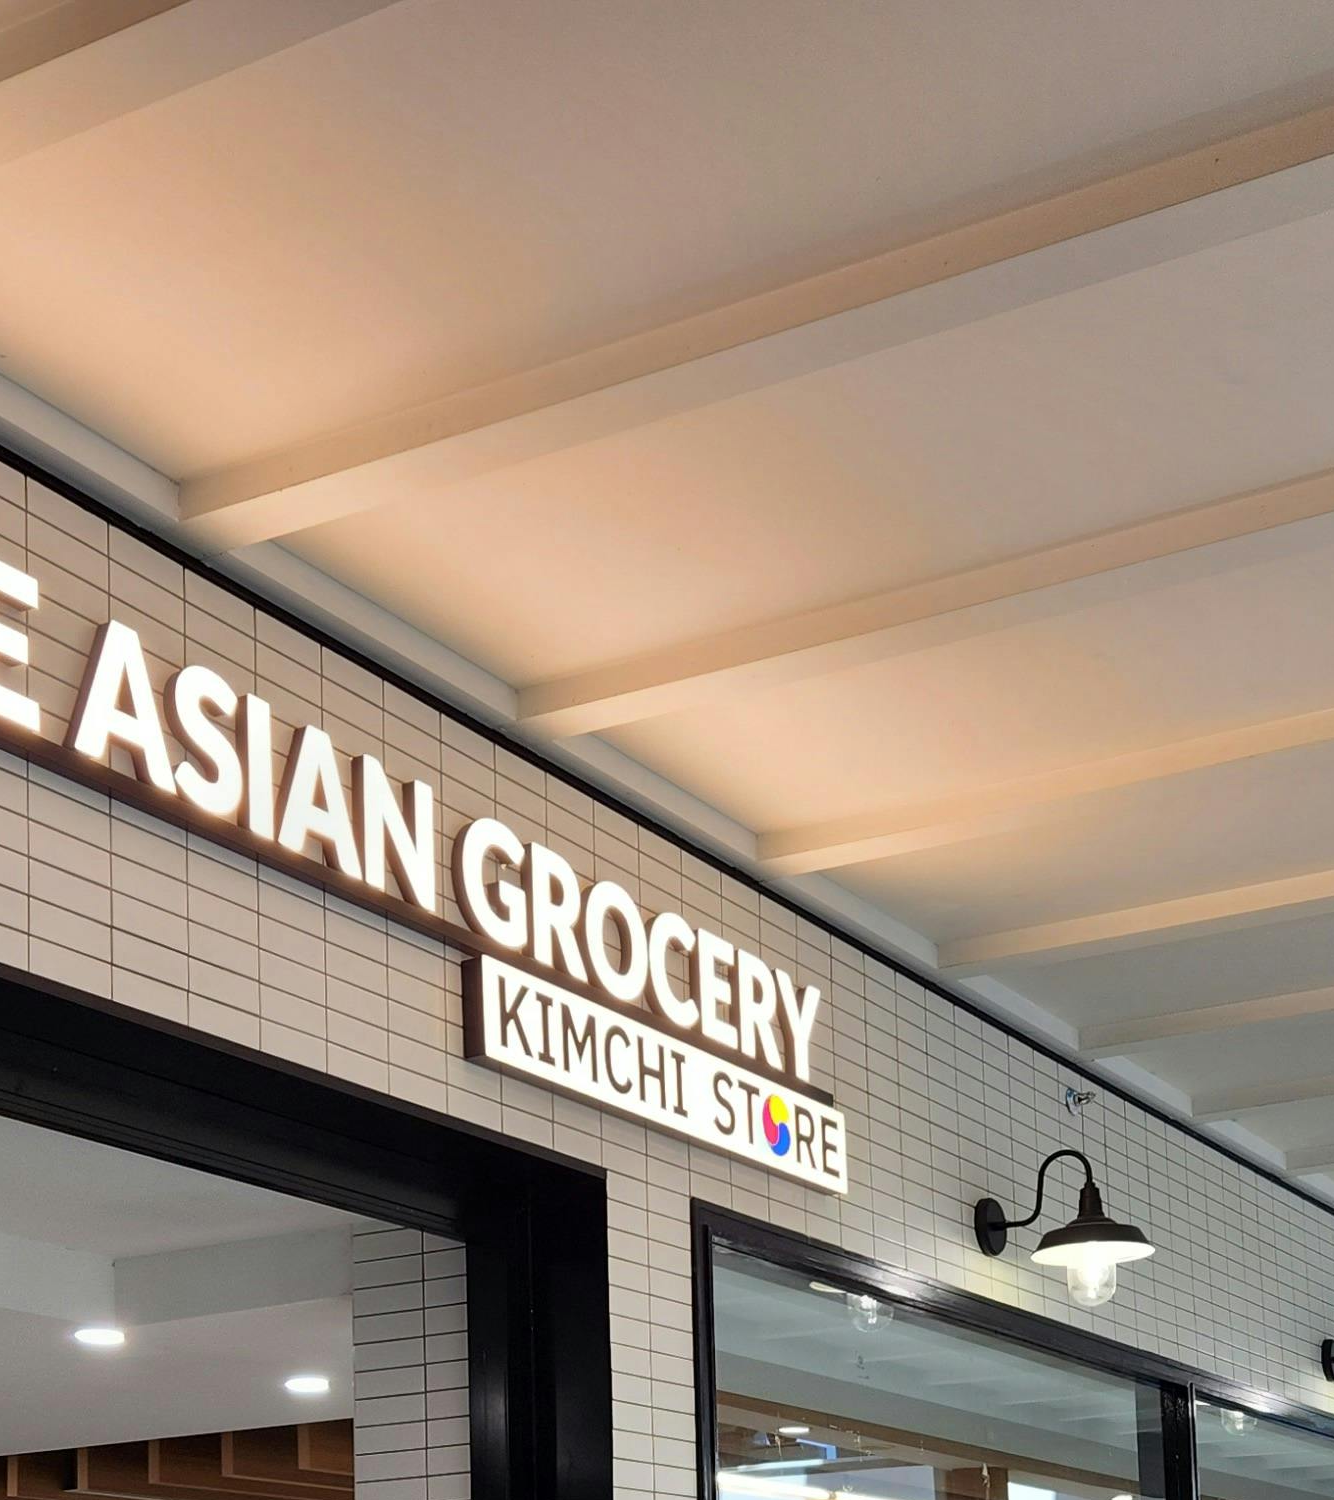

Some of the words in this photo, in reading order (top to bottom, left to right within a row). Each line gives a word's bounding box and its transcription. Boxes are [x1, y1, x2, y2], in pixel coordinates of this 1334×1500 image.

[71, 620, 436, 913] ASIAN
[455, 816, 822, 1083] GROCERY
[497, 974, 689, 1119] KIMCHI
